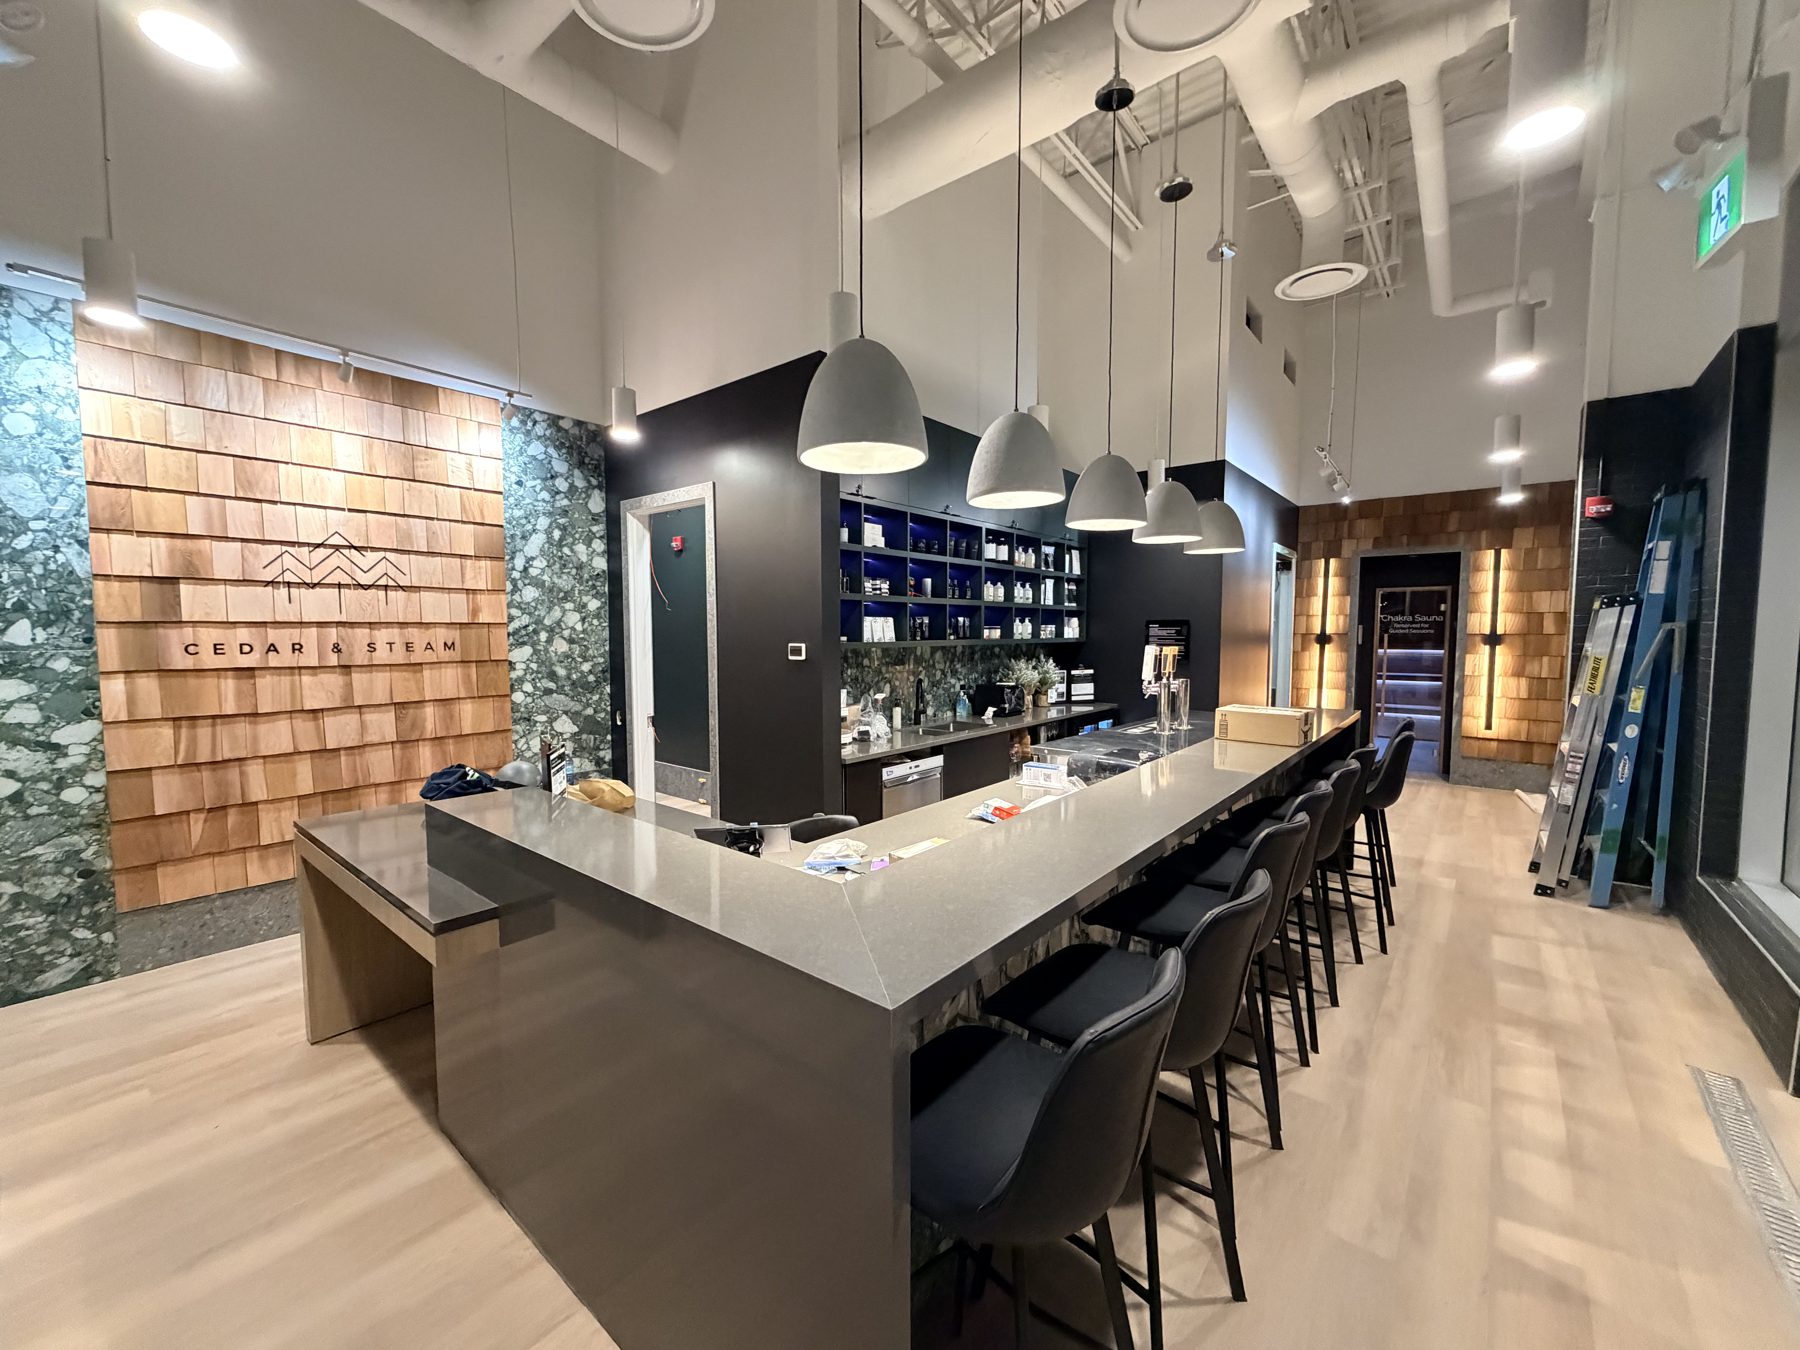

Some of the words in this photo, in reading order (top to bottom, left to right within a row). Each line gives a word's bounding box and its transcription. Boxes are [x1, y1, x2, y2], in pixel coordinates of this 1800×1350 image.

[1381, 614, 1412, 622] Chakra
[1414, 614, 1443, 622] Sauna
[184, 642, 304, 655] CEDAR
[331, 642, 343, 654] &
[367, 641, 456, 653] STEAM
[1587, 656, 1602, 693] FEATHERLITE
